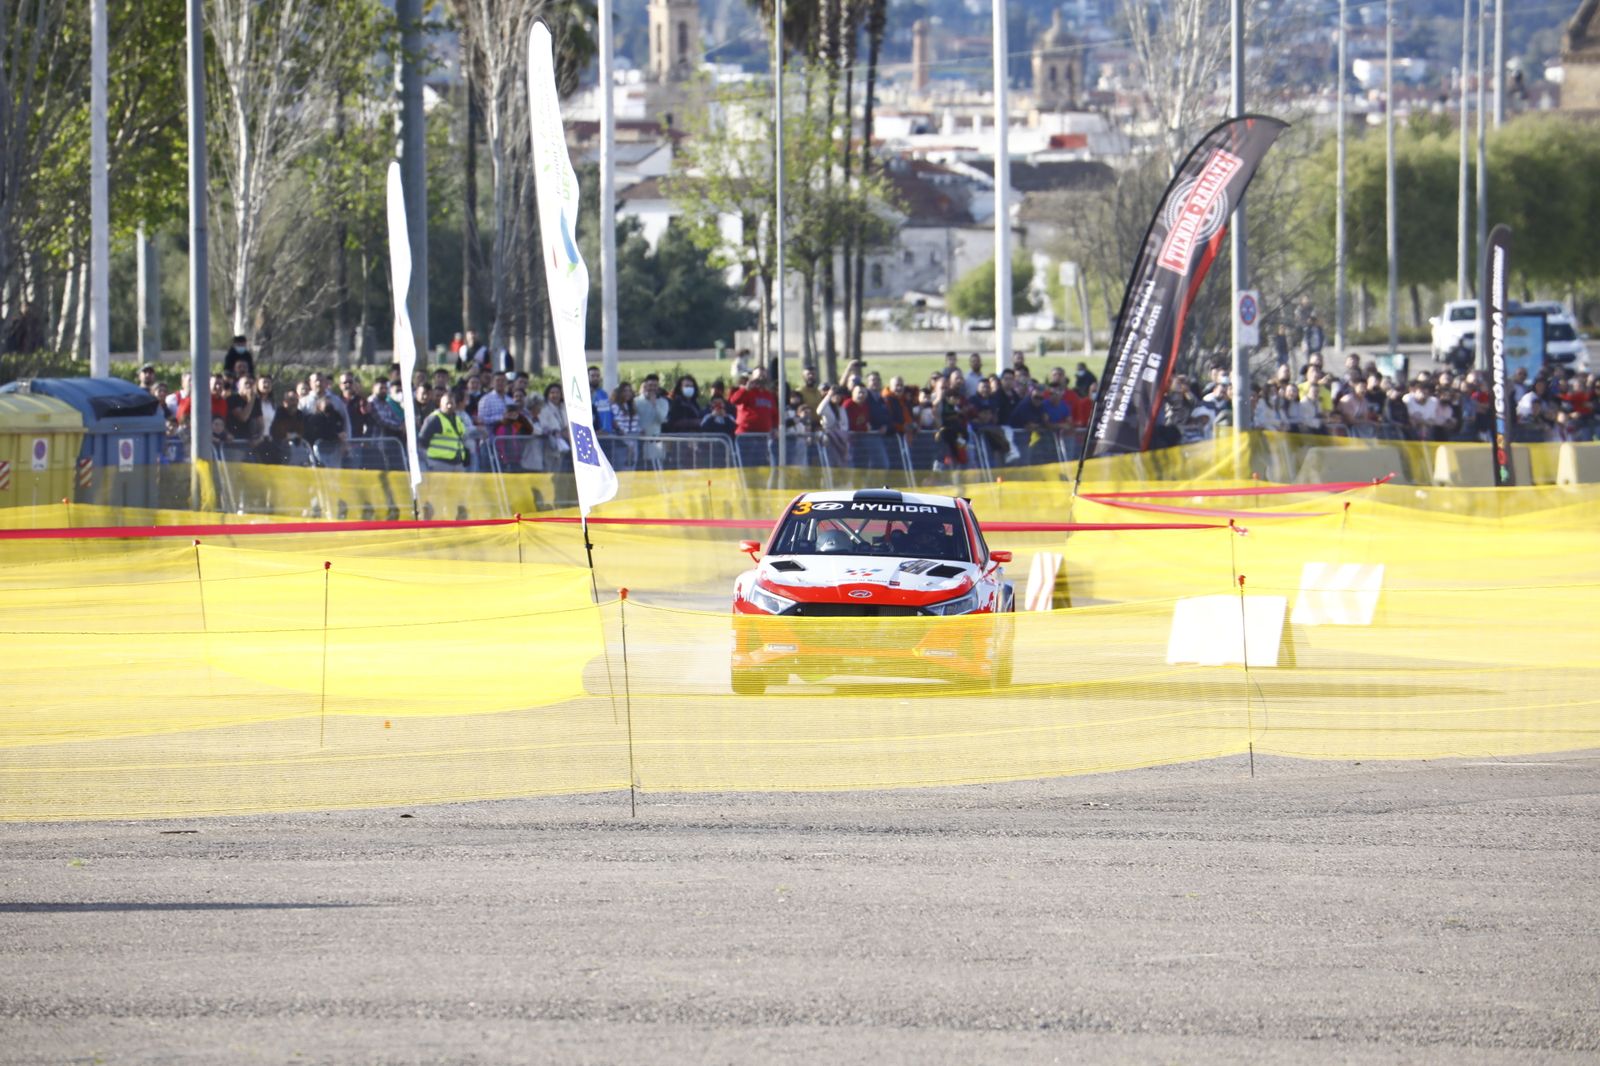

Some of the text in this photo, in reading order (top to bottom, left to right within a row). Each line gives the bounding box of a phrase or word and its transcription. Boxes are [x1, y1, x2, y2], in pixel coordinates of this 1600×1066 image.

[1165, 154, 1236, 264] TIENDA RALLYE
[792, 502, 938, 515] 3 HYUNDAI
